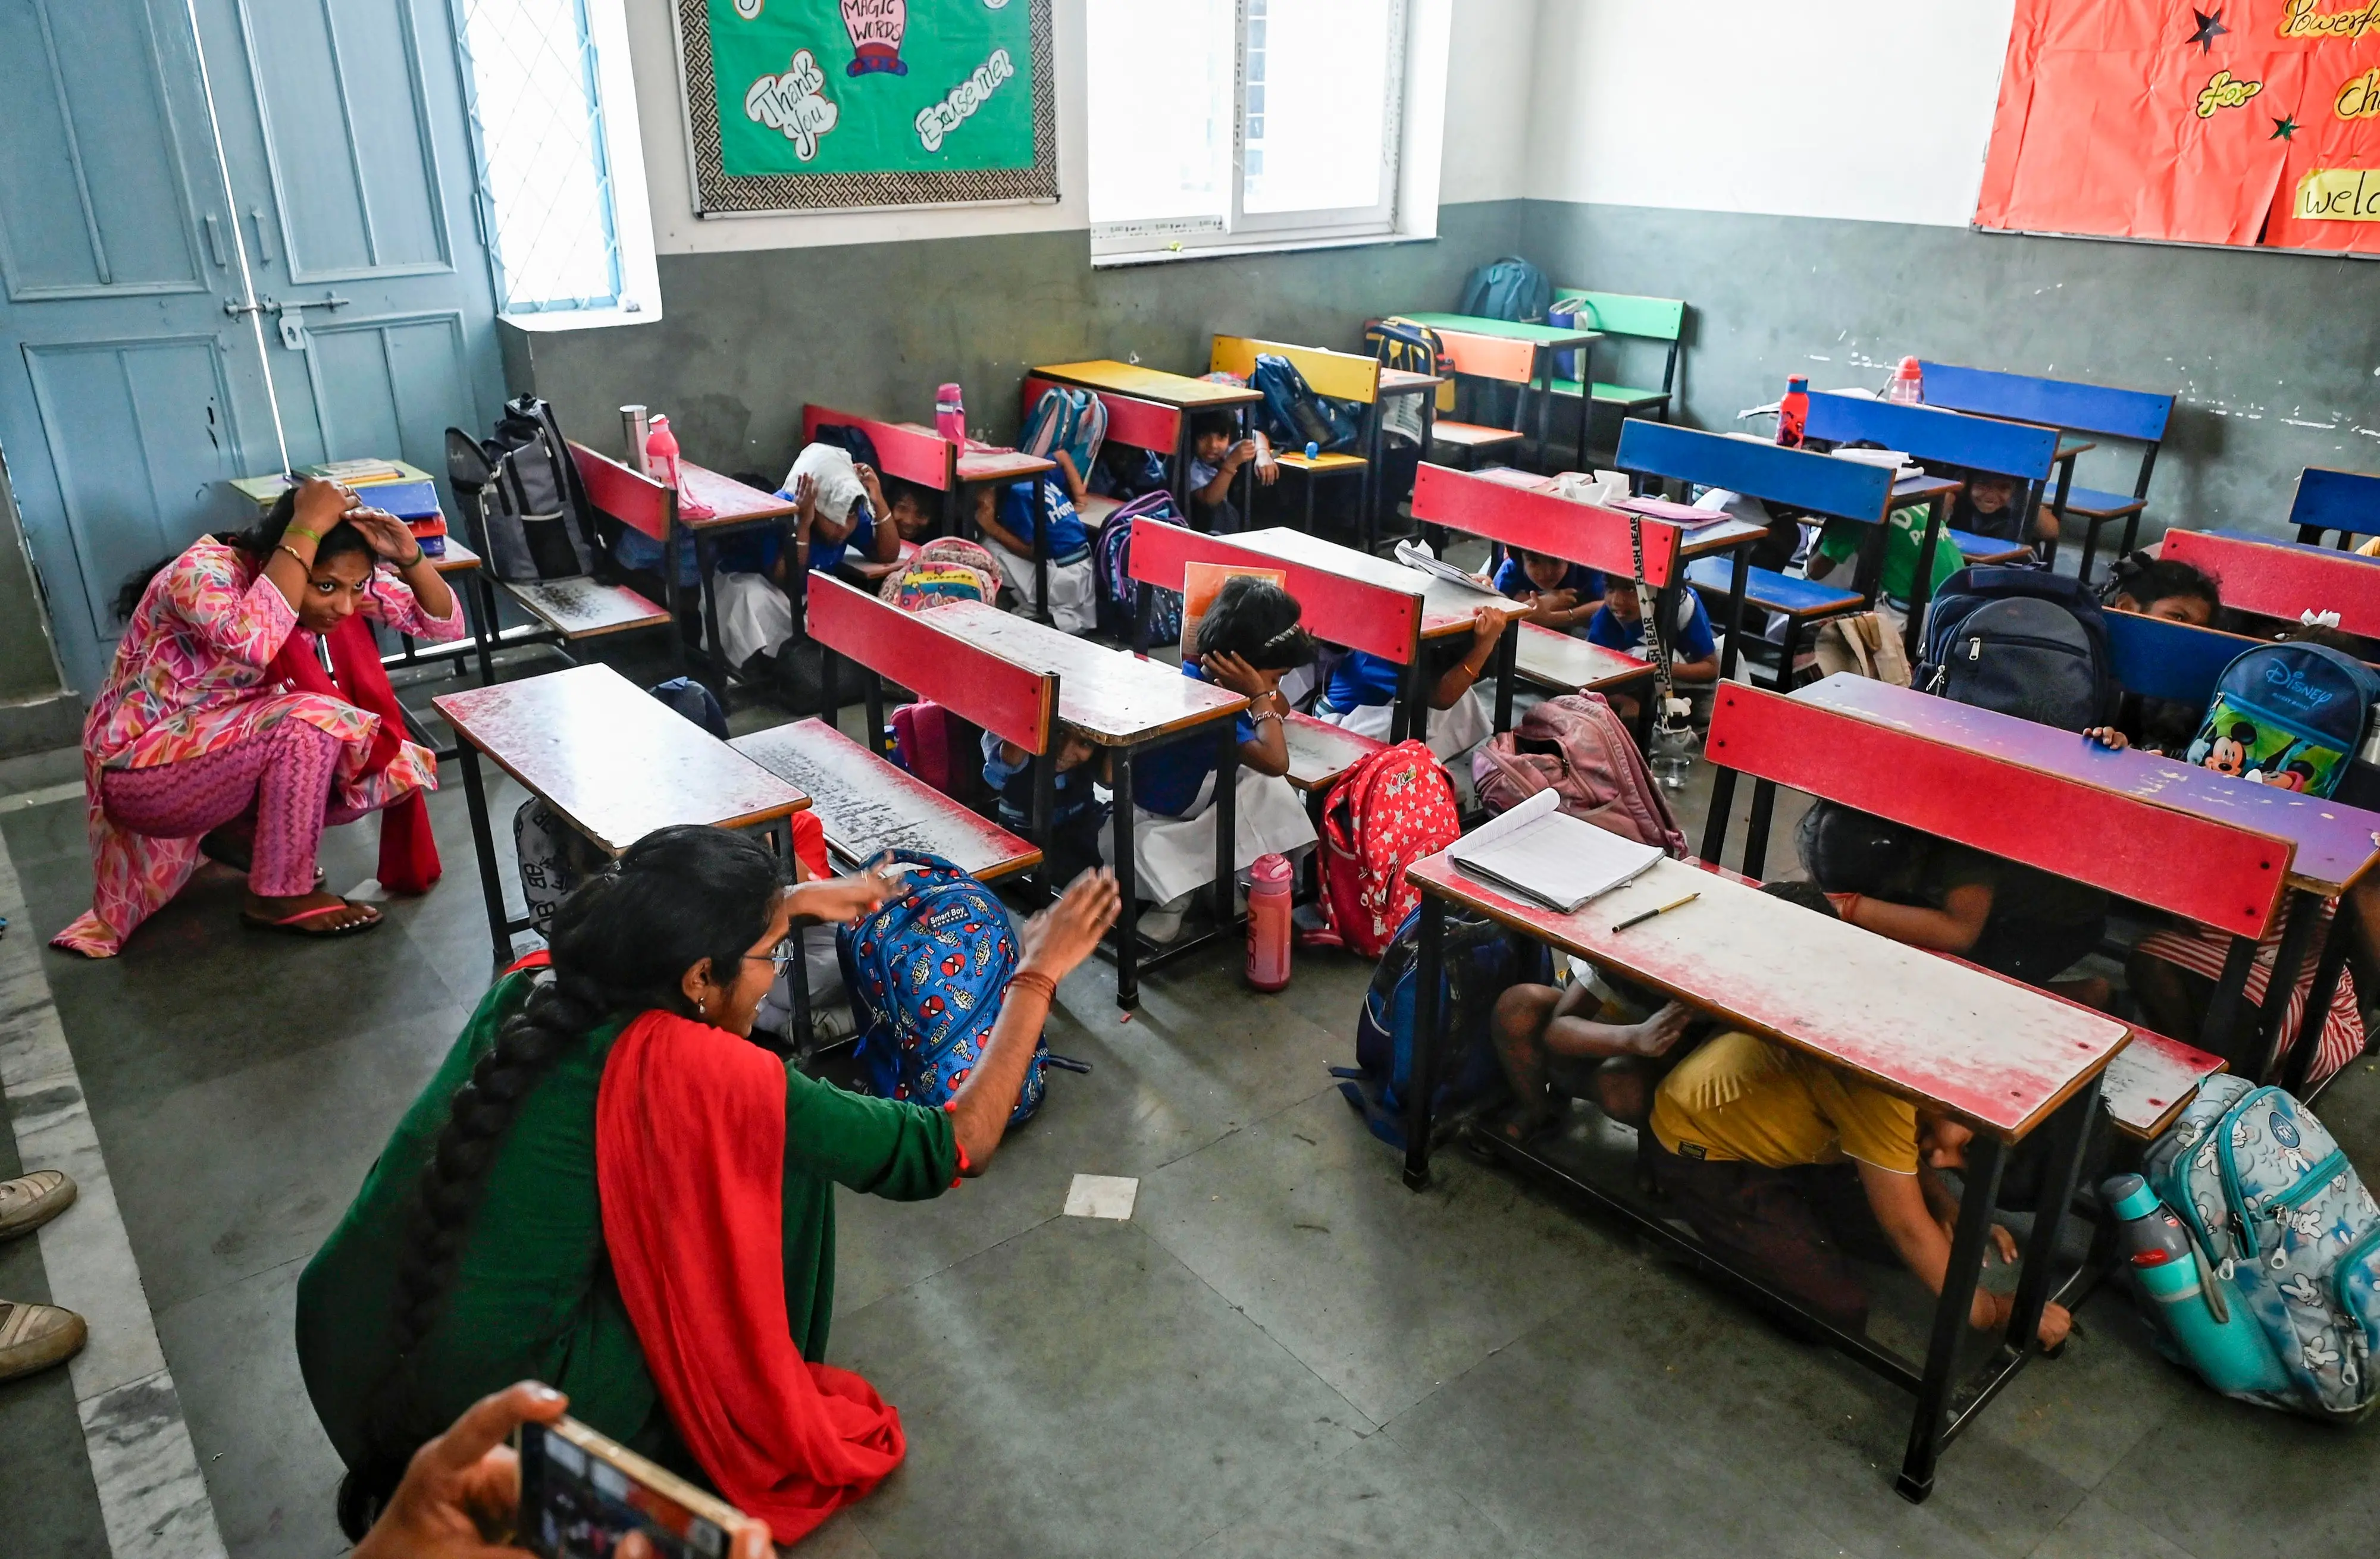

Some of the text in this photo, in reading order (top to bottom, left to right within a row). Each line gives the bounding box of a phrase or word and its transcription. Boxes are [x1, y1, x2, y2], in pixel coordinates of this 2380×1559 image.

[844, 0, 895, 20] MAGIC
[853, 20, 901, 42] WORDS
[750, 58, 821, 123] Thank
[2202, 74, 2254, 114] for
[1630, 517, 1644, 585] FLASH BEAR
[1643, 617, 1658, 646] BEAR
[930, 906, 964, 924] Smart Boy
